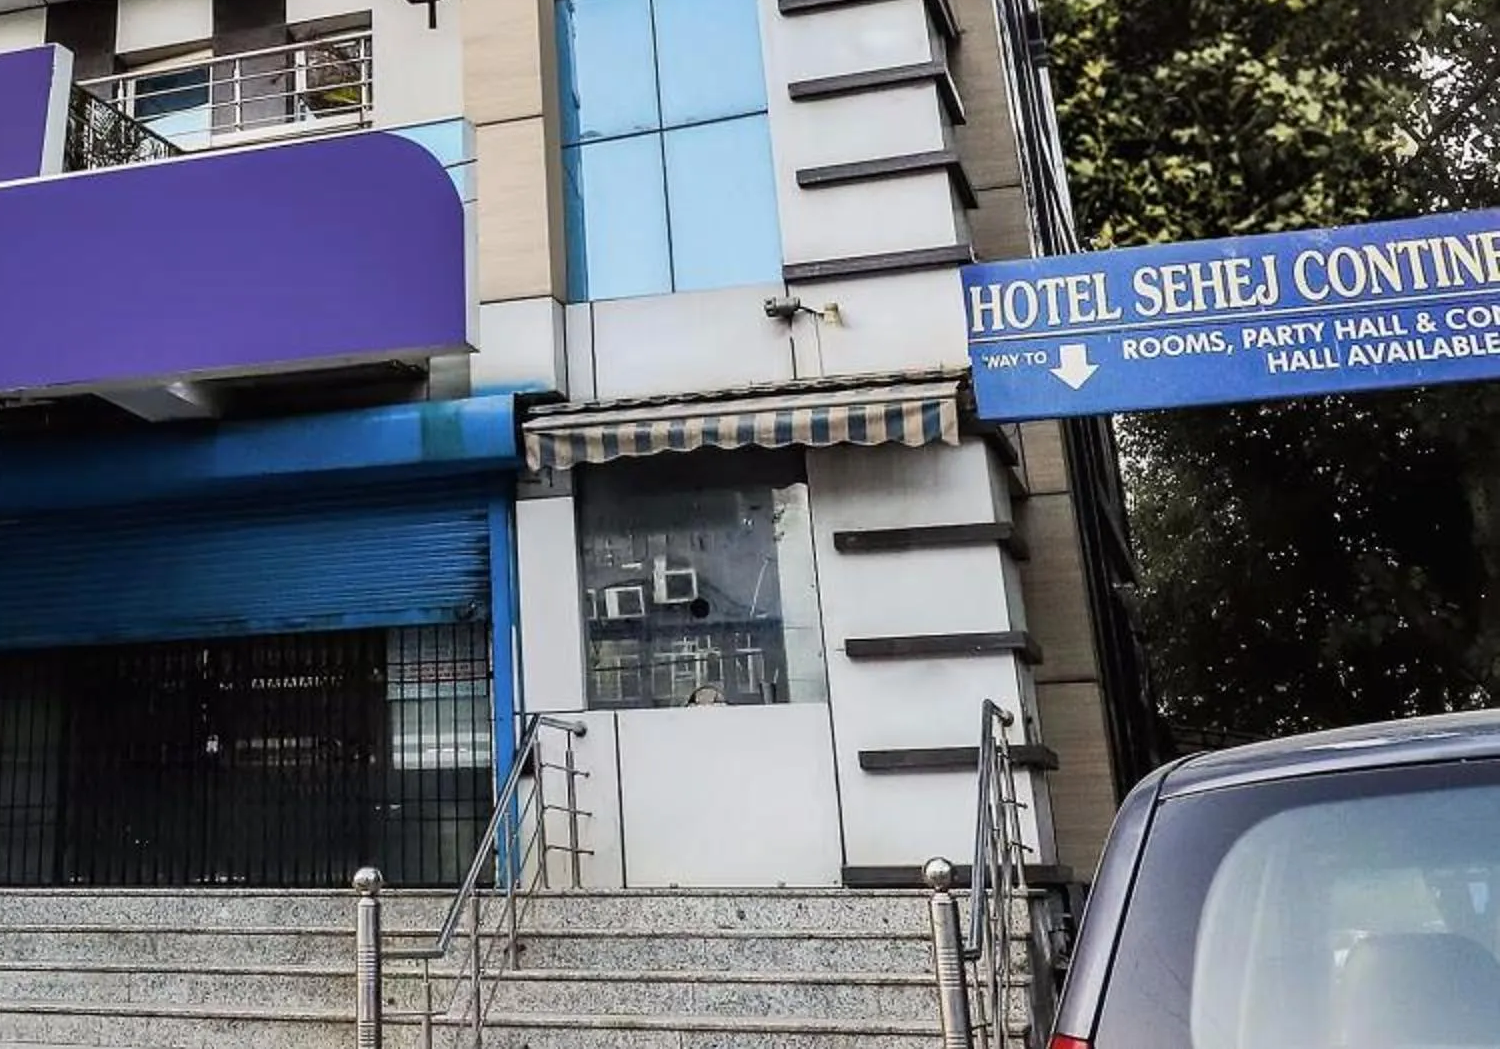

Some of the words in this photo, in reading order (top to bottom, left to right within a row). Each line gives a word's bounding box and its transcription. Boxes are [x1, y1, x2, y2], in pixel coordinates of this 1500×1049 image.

[970, 272, 1123, 332] HOTEL
[1133, 255, 1279, 316] SEHEJ
[1123, 331, 1233, 360] ROOMS,
[1242, 322, 1324, 348] PARTY
[1335, 314, 1408, 340] HALL
[1416, 312, 1437, 333] &
[1268, 348, 1340, 373] HALL
[1348, 333, 1500, 366] AVAILABLE
[981, 353, 1020, 369] WAY
[1022, 351, 1047, 366] TO
